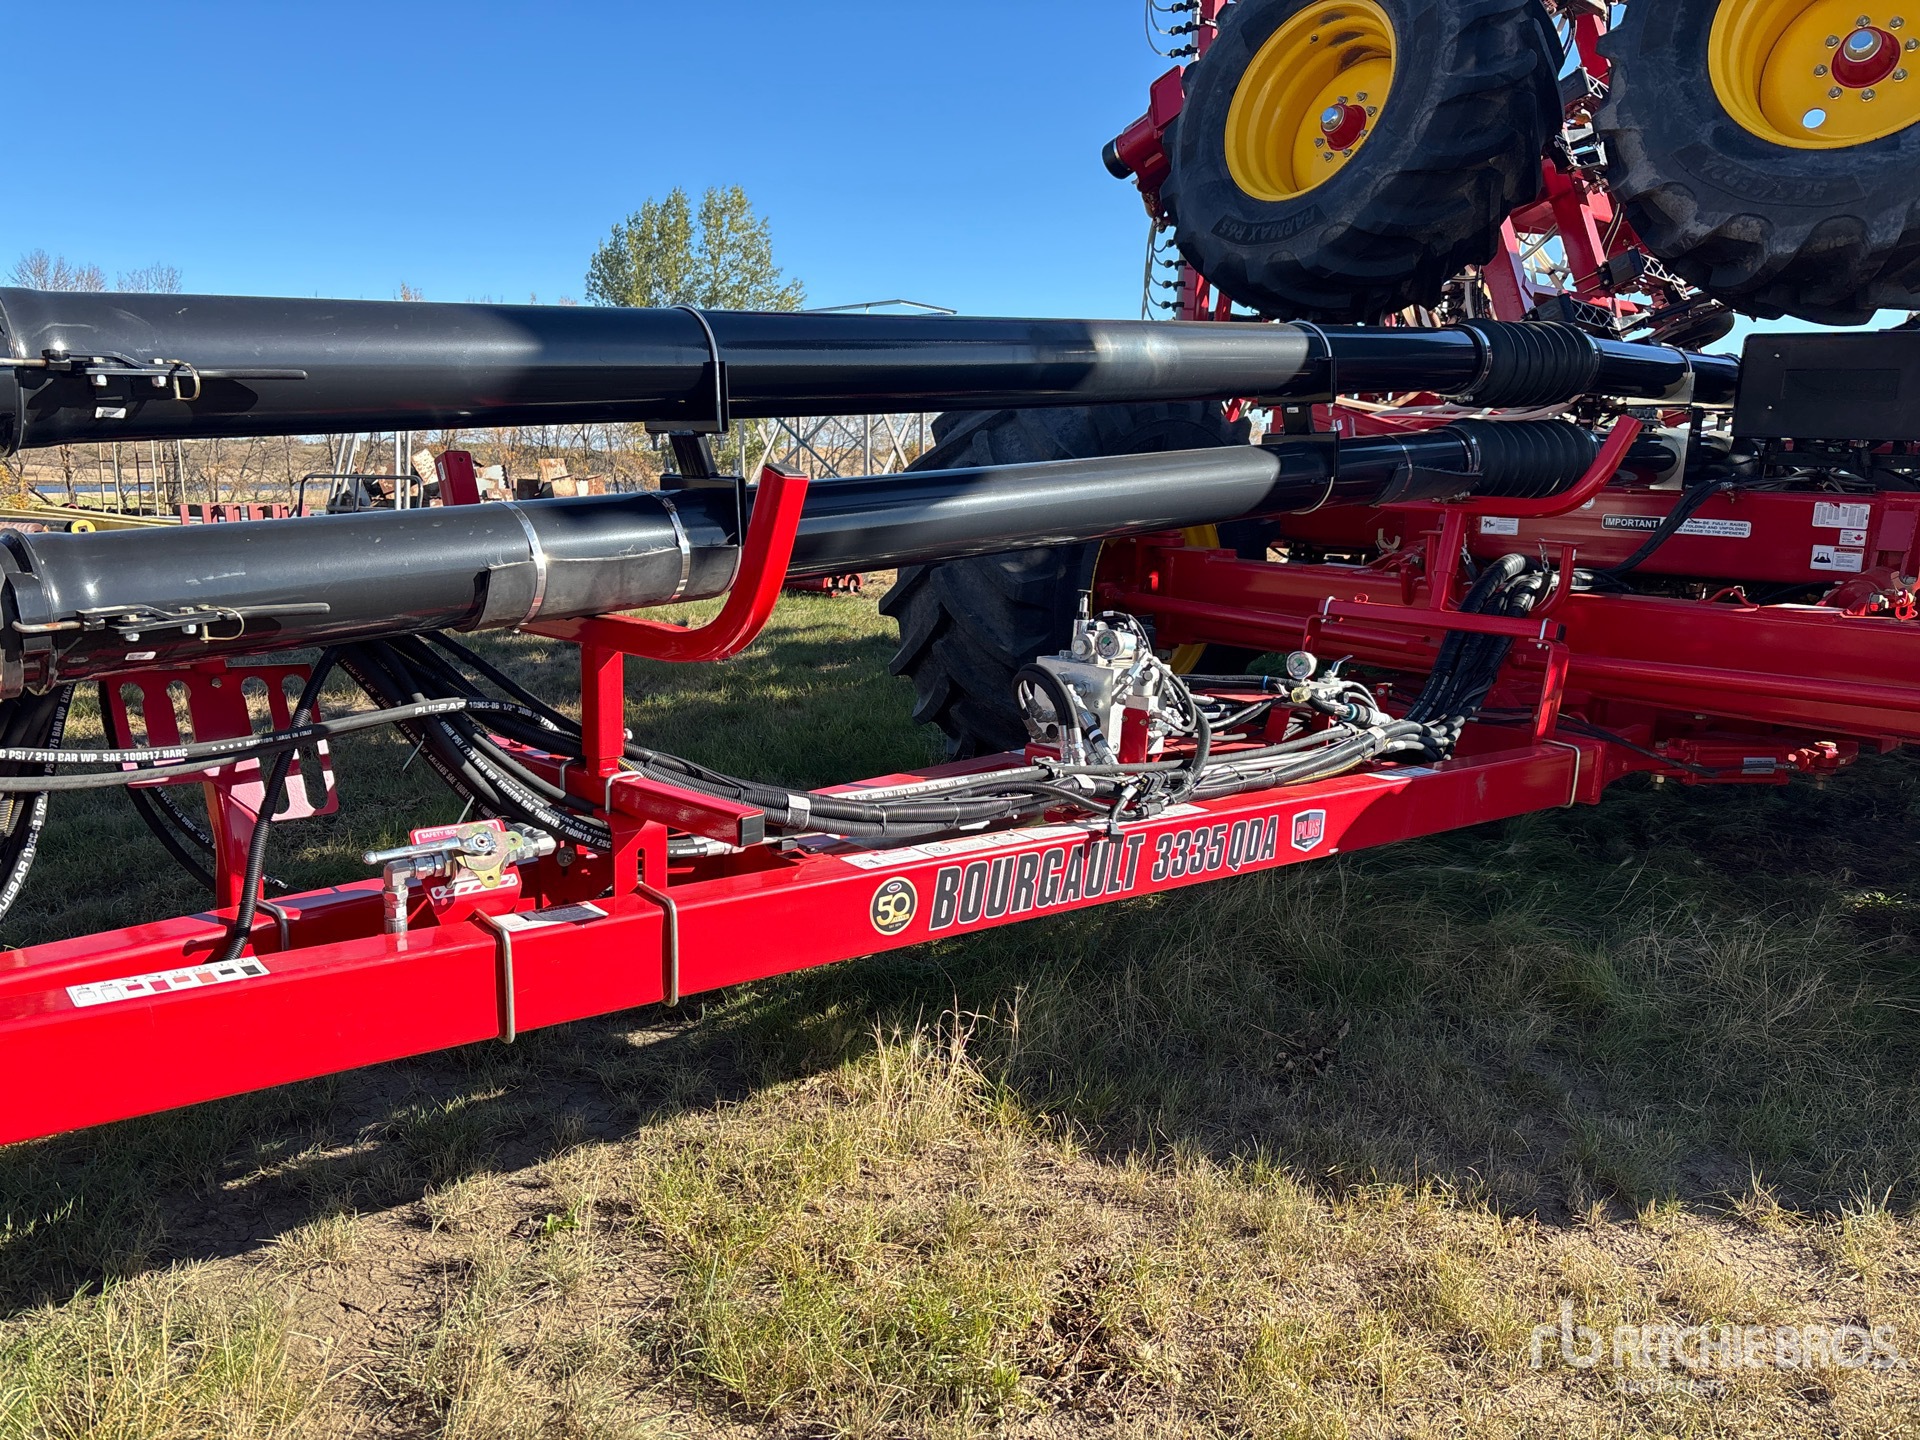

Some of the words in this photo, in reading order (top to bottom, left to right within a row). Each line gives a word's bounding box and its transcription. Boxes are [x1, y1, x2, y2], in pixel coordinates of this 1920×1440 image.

[1248, 207, 1316, 241] FARMAX
[1605, 517, 1658, 529] IMPORTANT
[55, 706, 66, 720] WP
[52, 719, 64, 737] BAR
[8, 750, 26, 760] PSI
[27, 750, 33, 761] /
[35, 752, 55, 762] 210
[58, 752, 78, 763] BAR
[80, 752, 98, 762] WP
[102, 752, 122, 762] SAE
[123, 750, 160, 762] 100R17
[162, 748, 188, 759] HARC
[452, 734, 464, 746] PSI
[463, 747, 477, 760] 275
[474, 758, 488, 772] BAR
[486, 768, 498, 780] WP
[496, 779, 522, 804] EXCEEDS
[520, 798, 536, 812] SAE
[534, 808, 560, 829] 100R16
[565, 826, 592, 843] 100R19
[34, 798, 47, 816] 1/2"
[421, 831, 444, 839] SAFETY
[928, 833, 1146, 932] BOURGAULT
[1151, 814, 1279, 883] 3335QDA
[876, 892, 911, 926] 50
